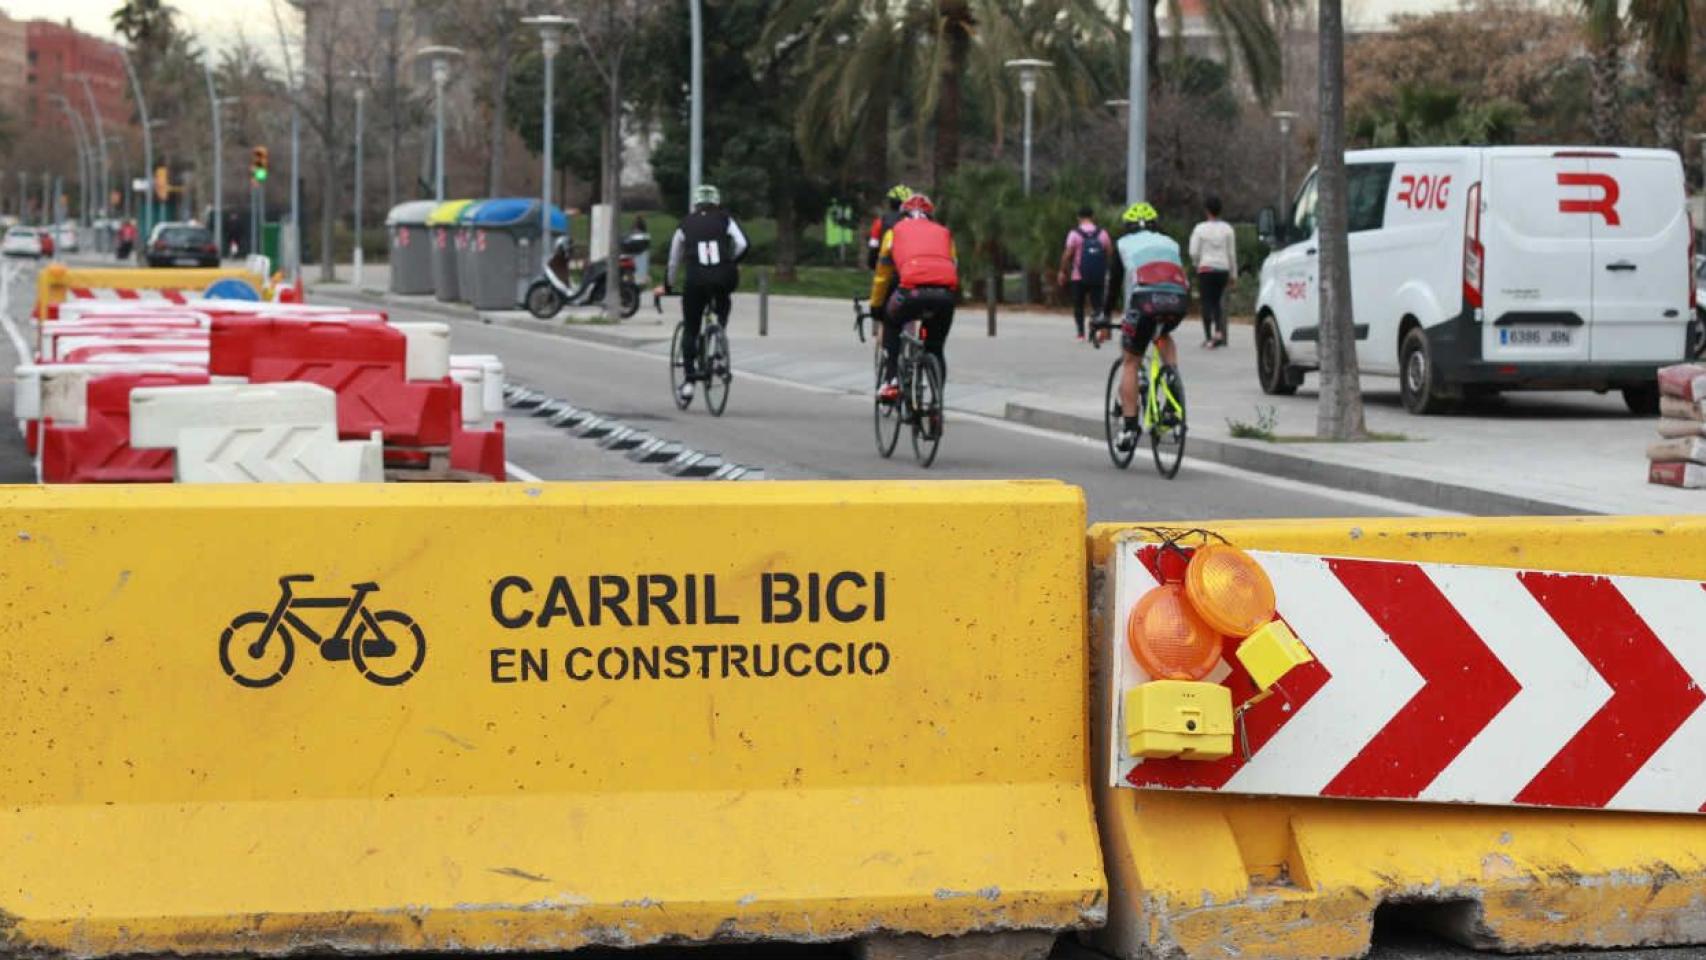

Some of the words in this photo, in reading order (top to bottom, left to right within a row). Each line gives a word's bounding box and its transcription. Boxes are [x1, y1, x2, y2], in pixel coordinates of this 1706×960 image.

[1397, 175, 1452, 210] ROIG
[491, 574, 739, 628] CARRIL
[761, 571, 886, 624] BICI
[491, 648, 548, 683] EN
[565, 642, 890, 681] CONSTRUCCIO
